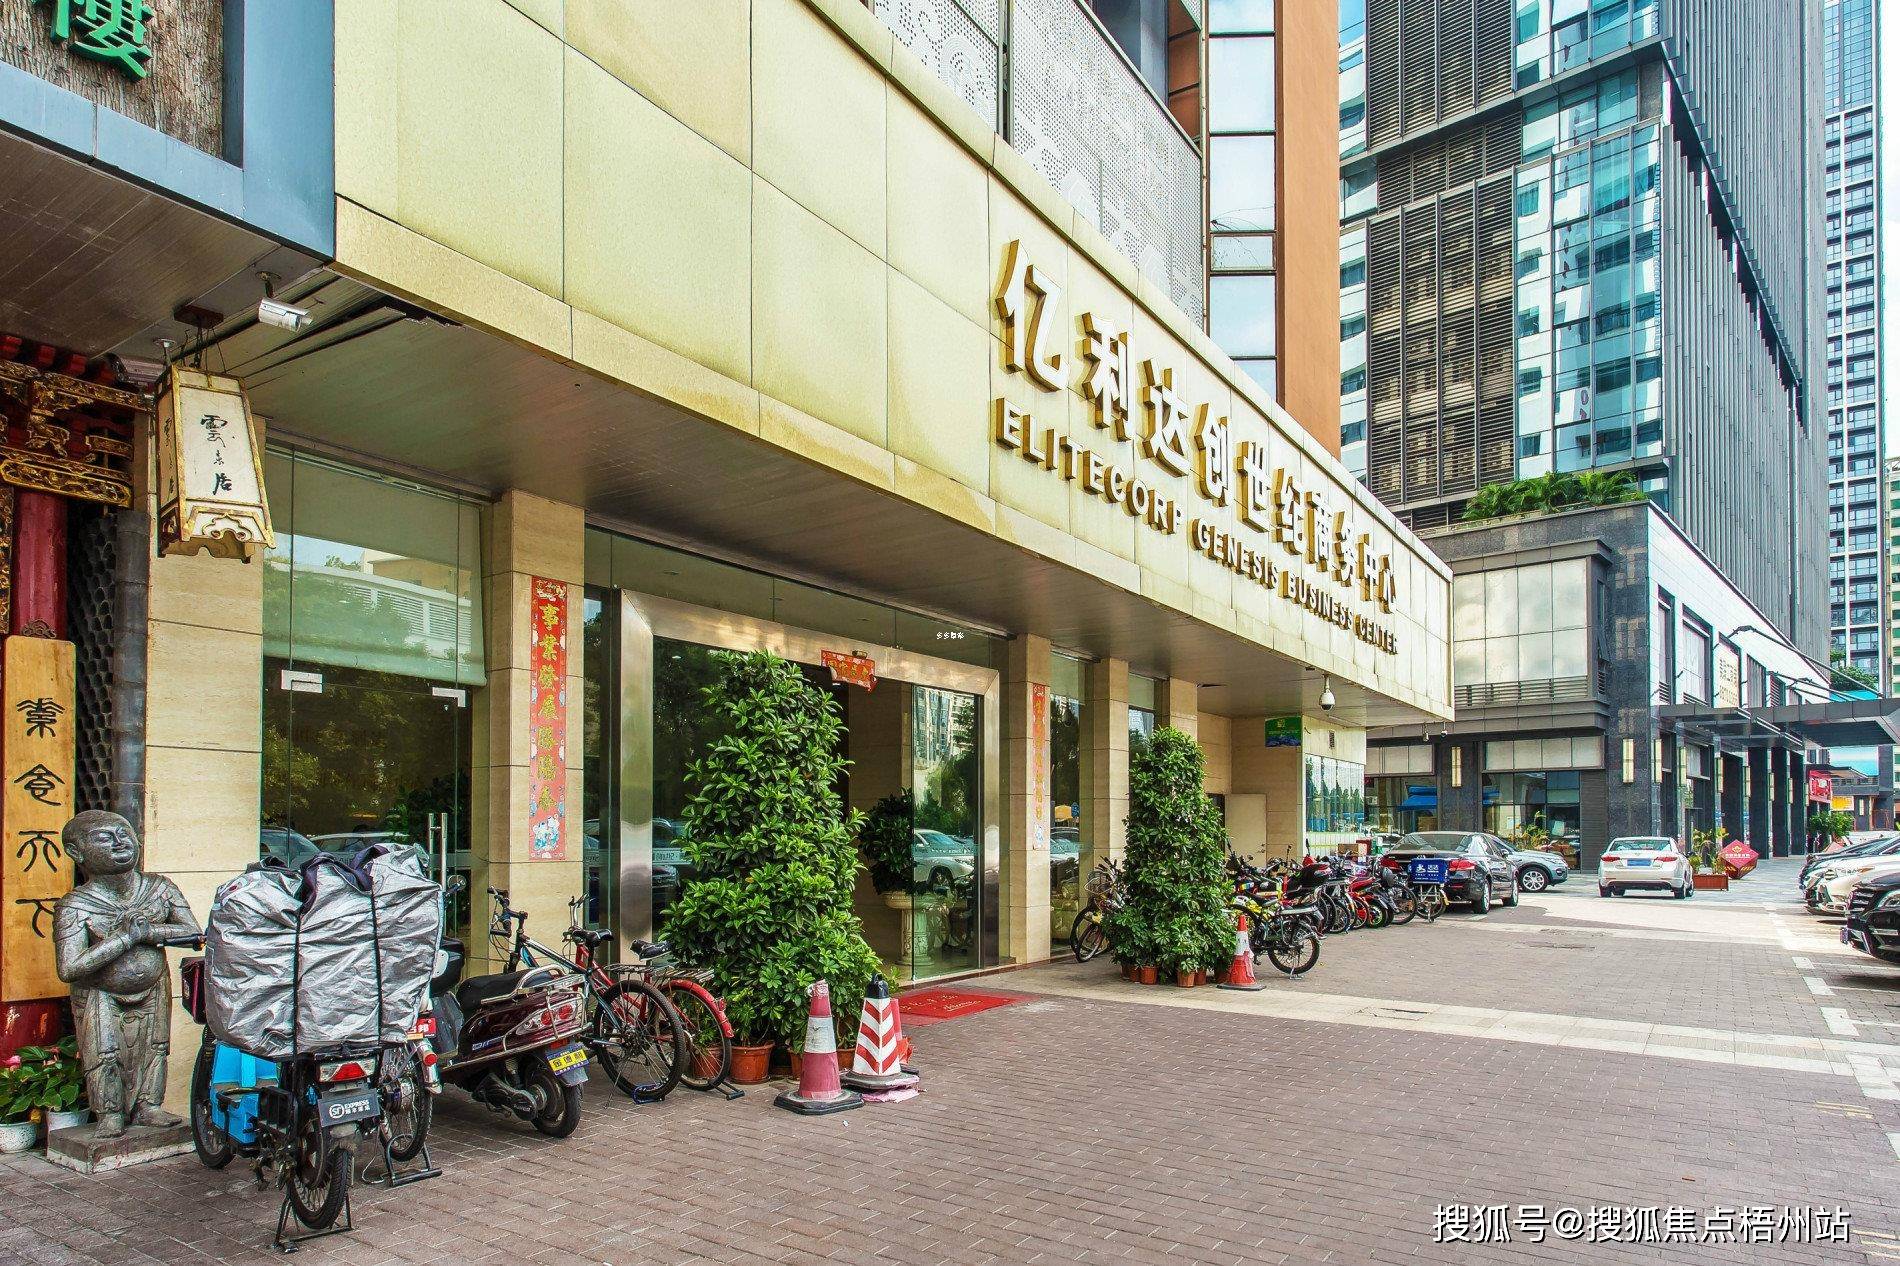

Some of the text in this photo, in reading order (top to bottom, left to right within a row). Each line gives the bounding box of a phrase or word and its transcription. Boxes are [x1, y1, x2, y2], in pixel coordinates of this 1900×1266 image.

[994, 238, 1397, 614] 亿利达创世纪商务中心
[995, 397, 1186, 535] ELITECORP
[1191, 518, 1278, 590] GENESIS
[1281, 570, 1353, 631] BUSINESS
